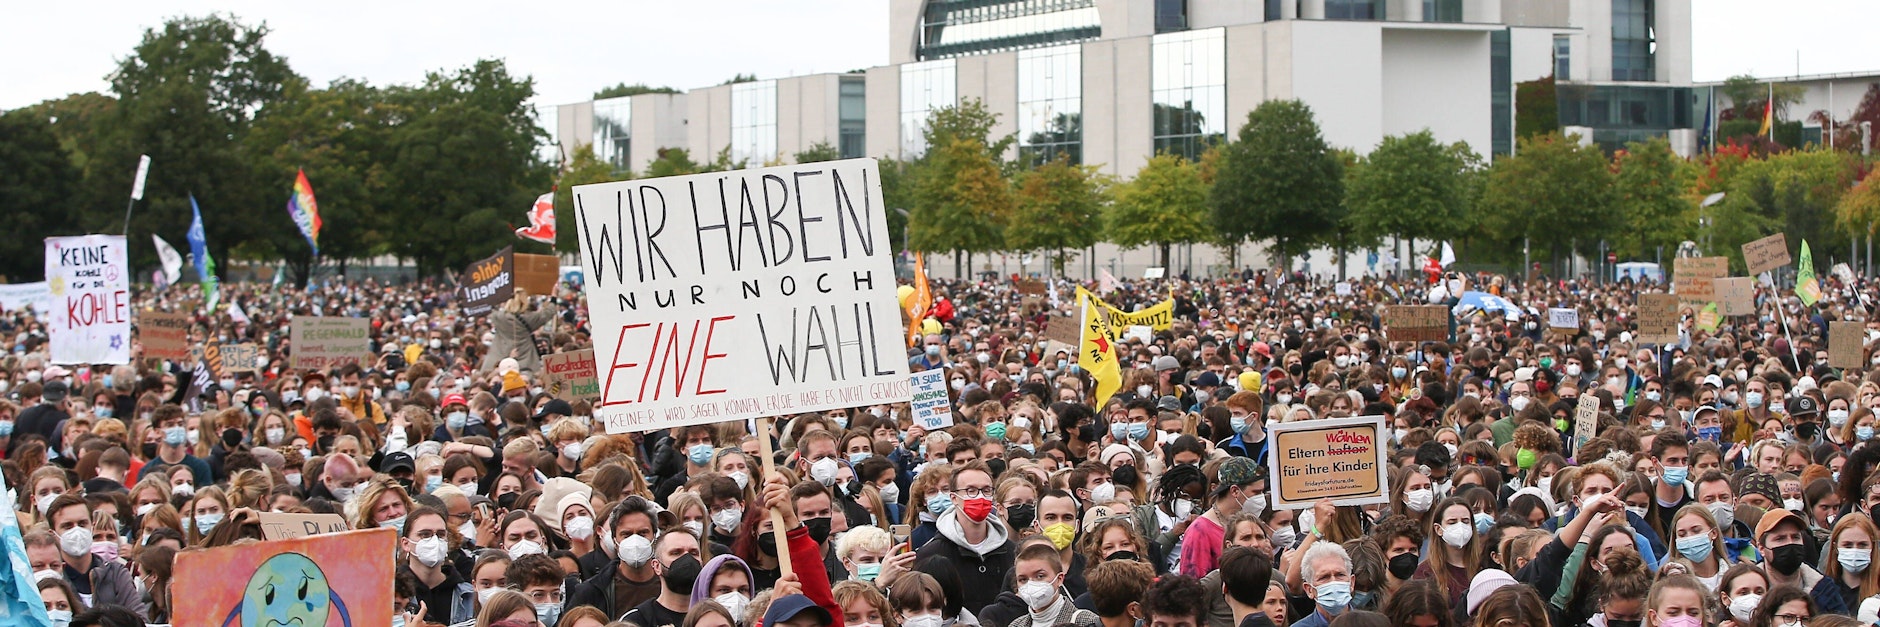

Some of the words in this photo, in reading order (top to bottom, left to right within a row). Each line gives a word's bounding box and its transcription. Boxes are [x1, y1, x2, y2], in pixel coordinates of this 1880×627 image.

[578, 185, 677, 288] WIR
[689, 168, 874, 275] HABEN
[60, 245, 108, 266] KEINE
[618, 284, 706, 312] NUR
[742, 270, 873, 300] NOCH
[67, 290, 126, 329] KOHLE
[302, 328, 365, 340] REGENWALD
[602, 315, 736, 406] EINE
[756, 301, 896, 386] WAHL
[923, 373, 943, 384] SURE
[664, 405, 686, 422] WIRD
[690, 400, 720, 419] SAGEN
[800, 389, 820, 408] HABE
[825, 387, 834, 402] ES
[838, 384, 864, 403] NICHT
[925, 417, 942, 427] TOO
[1288, 447, 1325, 459] Eltern
[1328, 443, 1368, 456] haften
[1283, 464, 1301, 477] für
[1305, 462, 1329, 475] ihre
[1333, 459, 1374, 473] Kinder
